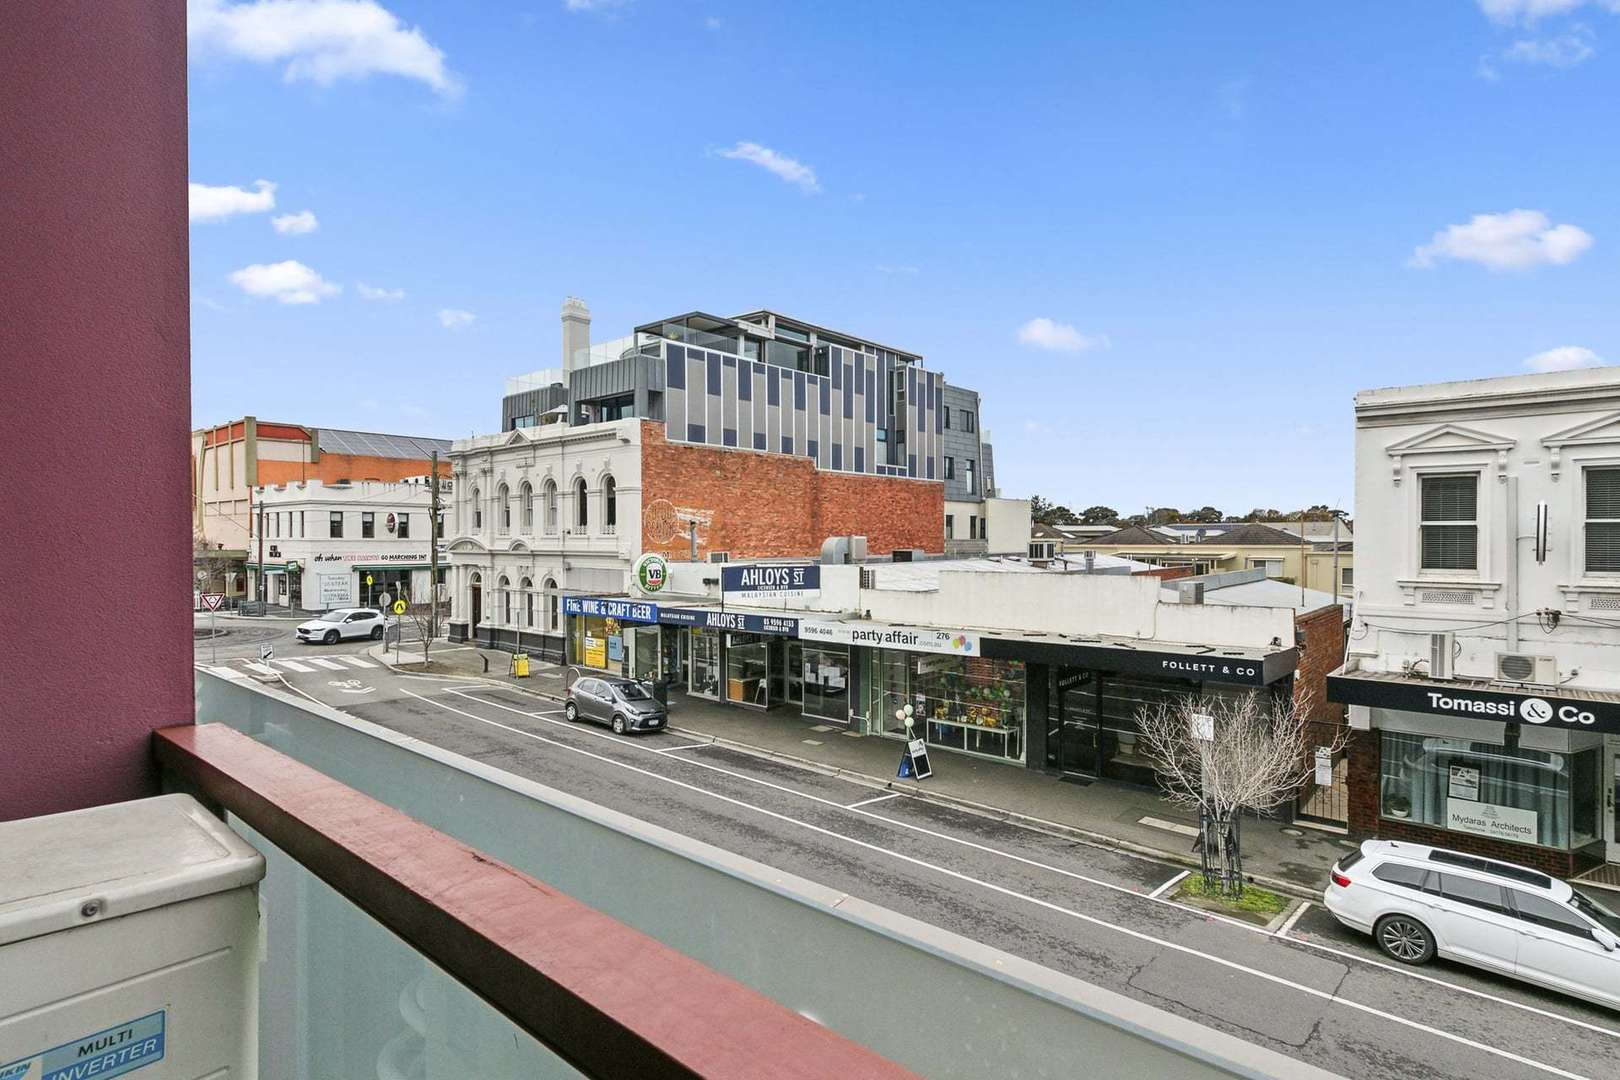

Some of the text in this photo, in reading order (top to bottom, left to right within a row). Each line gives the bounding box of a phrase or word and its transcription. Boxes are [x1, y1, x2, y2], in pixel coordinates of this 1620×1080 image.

[314, 553, 323, 562] oh
[325, 554, 342, 562] when
[648, 569, 662, 579] VB
[741, 568, 805, 586] AHLOYS ST
[582, 600, 599, 614] WINE
[600, 601, 606, 615] &
[608, 602, 630, 617] CRAFT
[632, 604, 651, 620] BEER
[706, 612, 745, 629] AHLOYS ST
[852, 629, 882, 645] party
[885, 630, 919, 645] affair
[936, 632, 950, 640] 276
[1162, 660, 1255, 676] FOLLETT & CO
[1427, 692, 1595, 724] Tomassi & Co
[1452, 814, 1487, 827] Mydaras
[1491, 820, 1532, 834] Architects
[78, 1029, 133, 1057] MULTI
